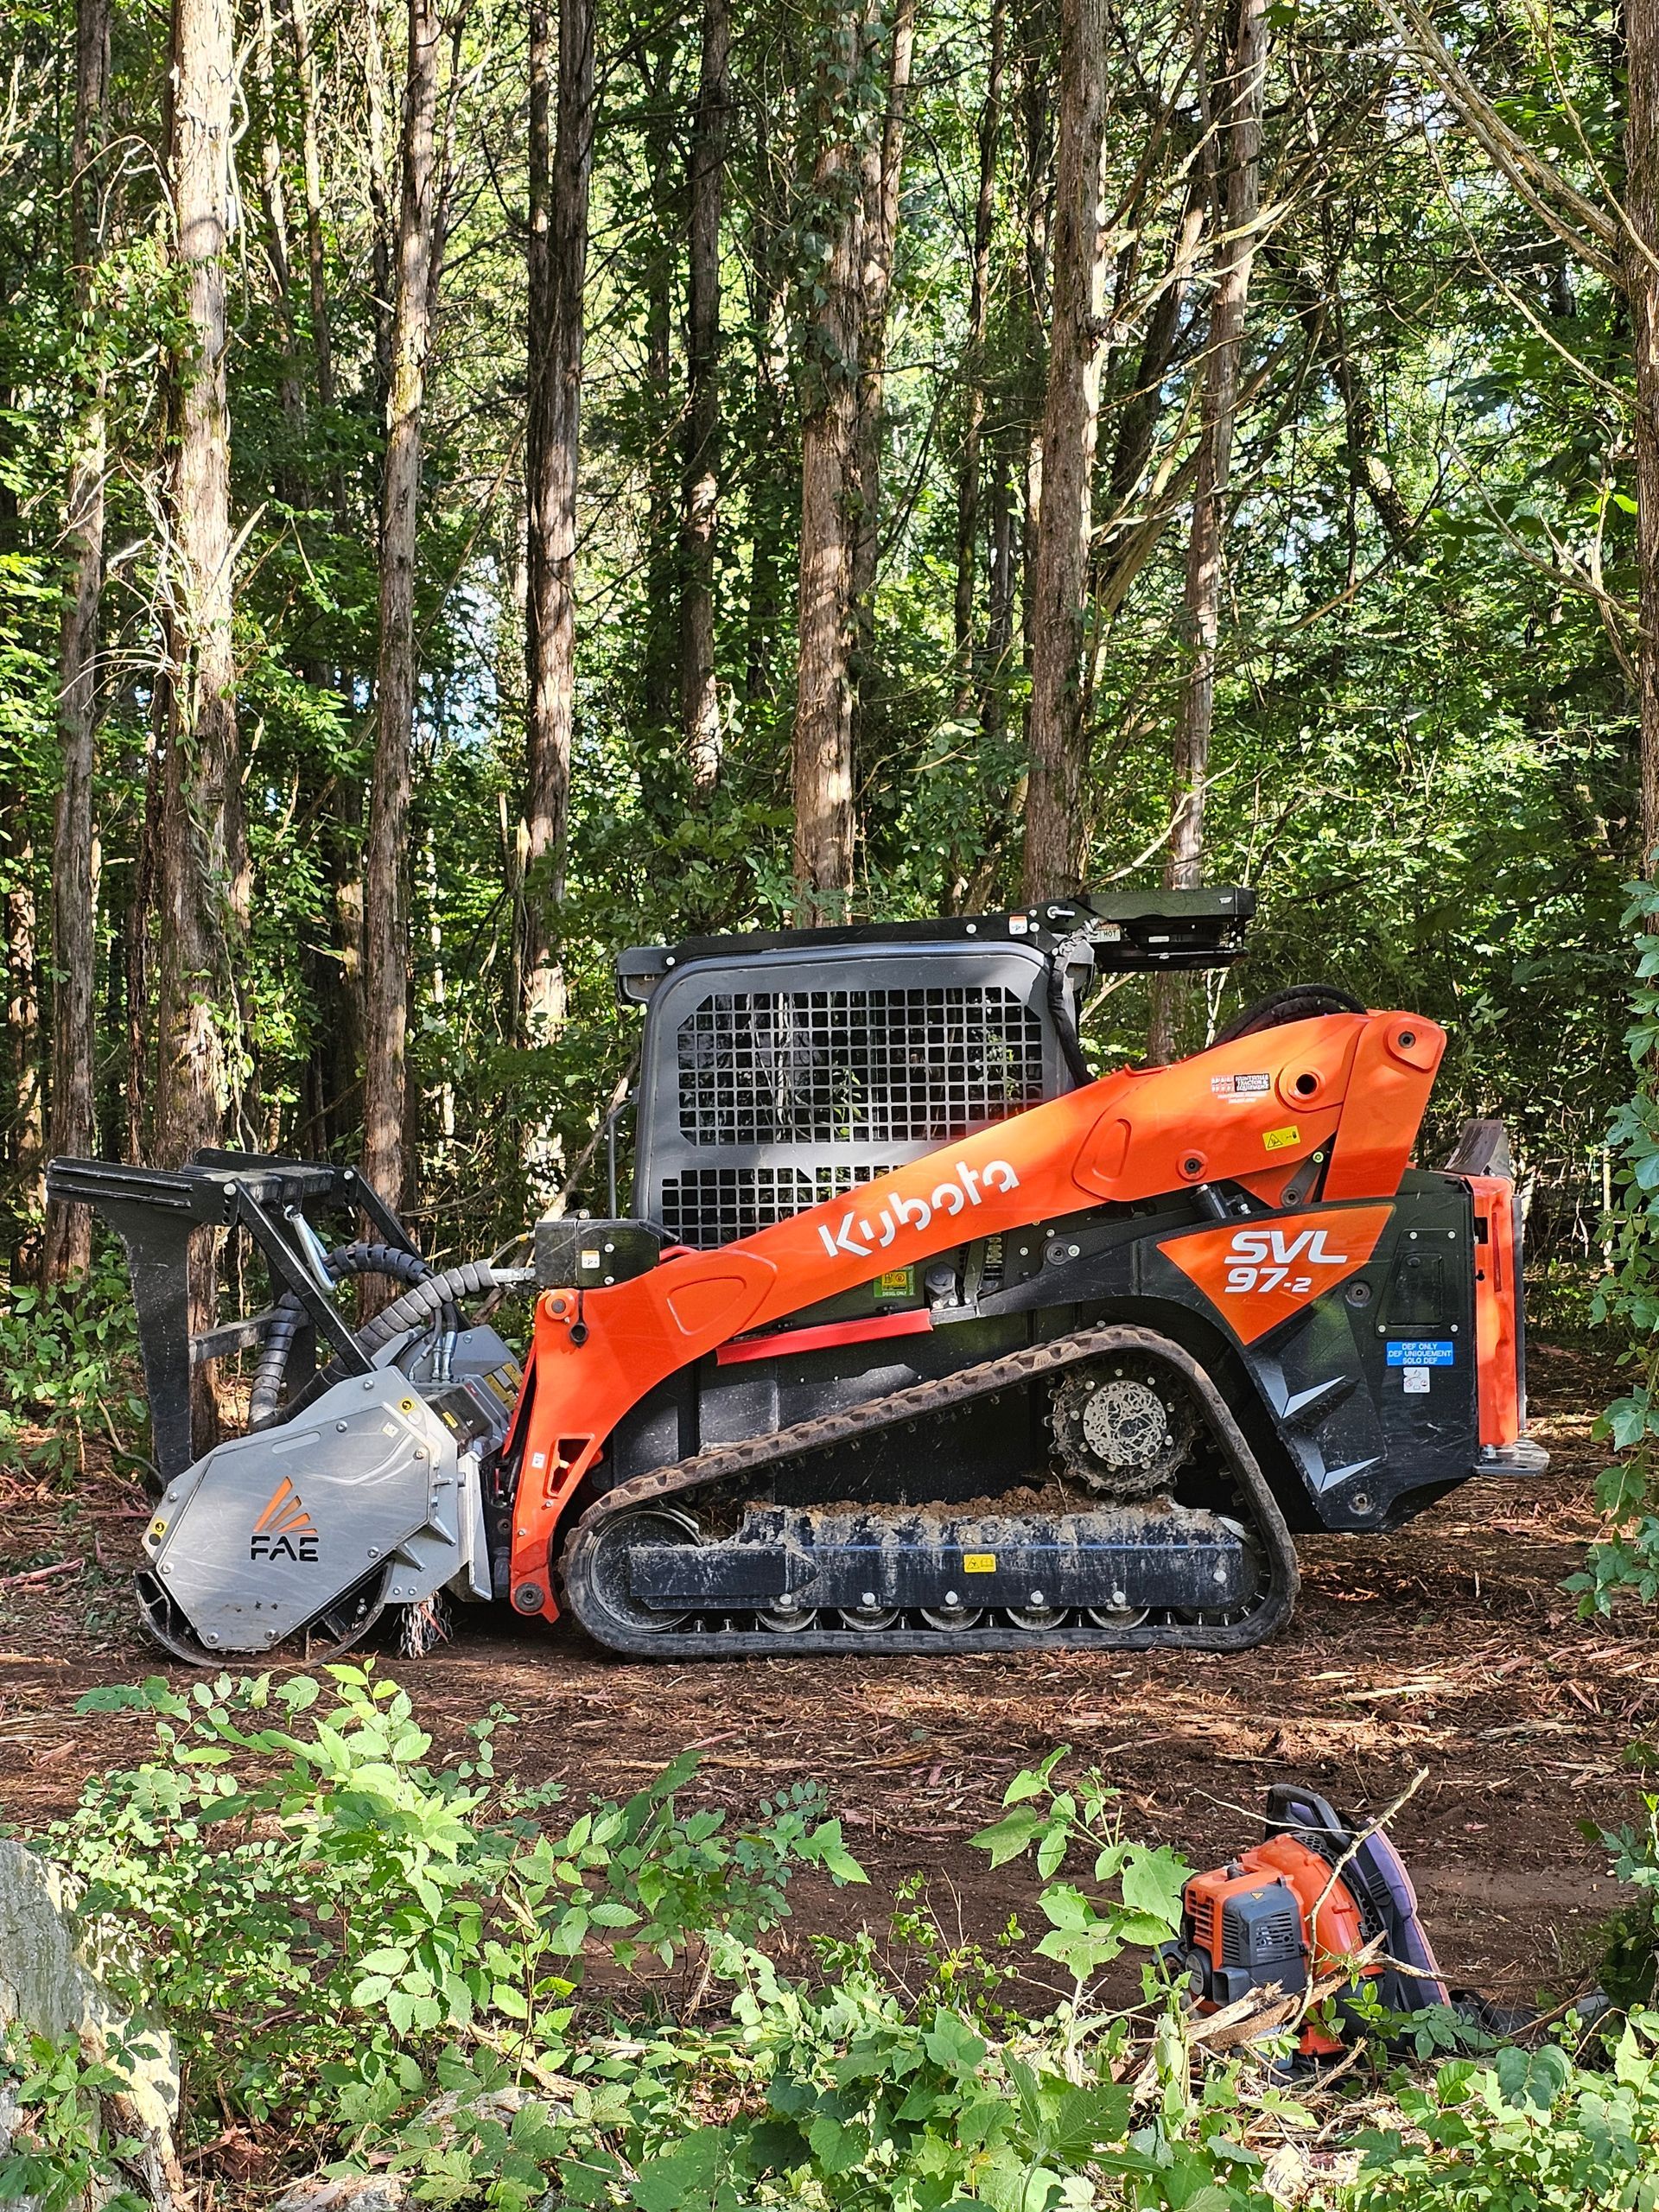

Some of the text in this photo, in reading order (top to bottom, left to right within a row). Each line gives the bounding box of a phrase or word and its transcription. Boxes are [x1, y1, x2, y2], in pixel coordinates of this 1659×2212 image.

[817, 1160, 1020, 1257] Kubota
[1224, 1230, 1348, 1263] SVL
[1224, 1267, 1312, 1293] 97-2
[251, 1535, 319, 1562] FAE
